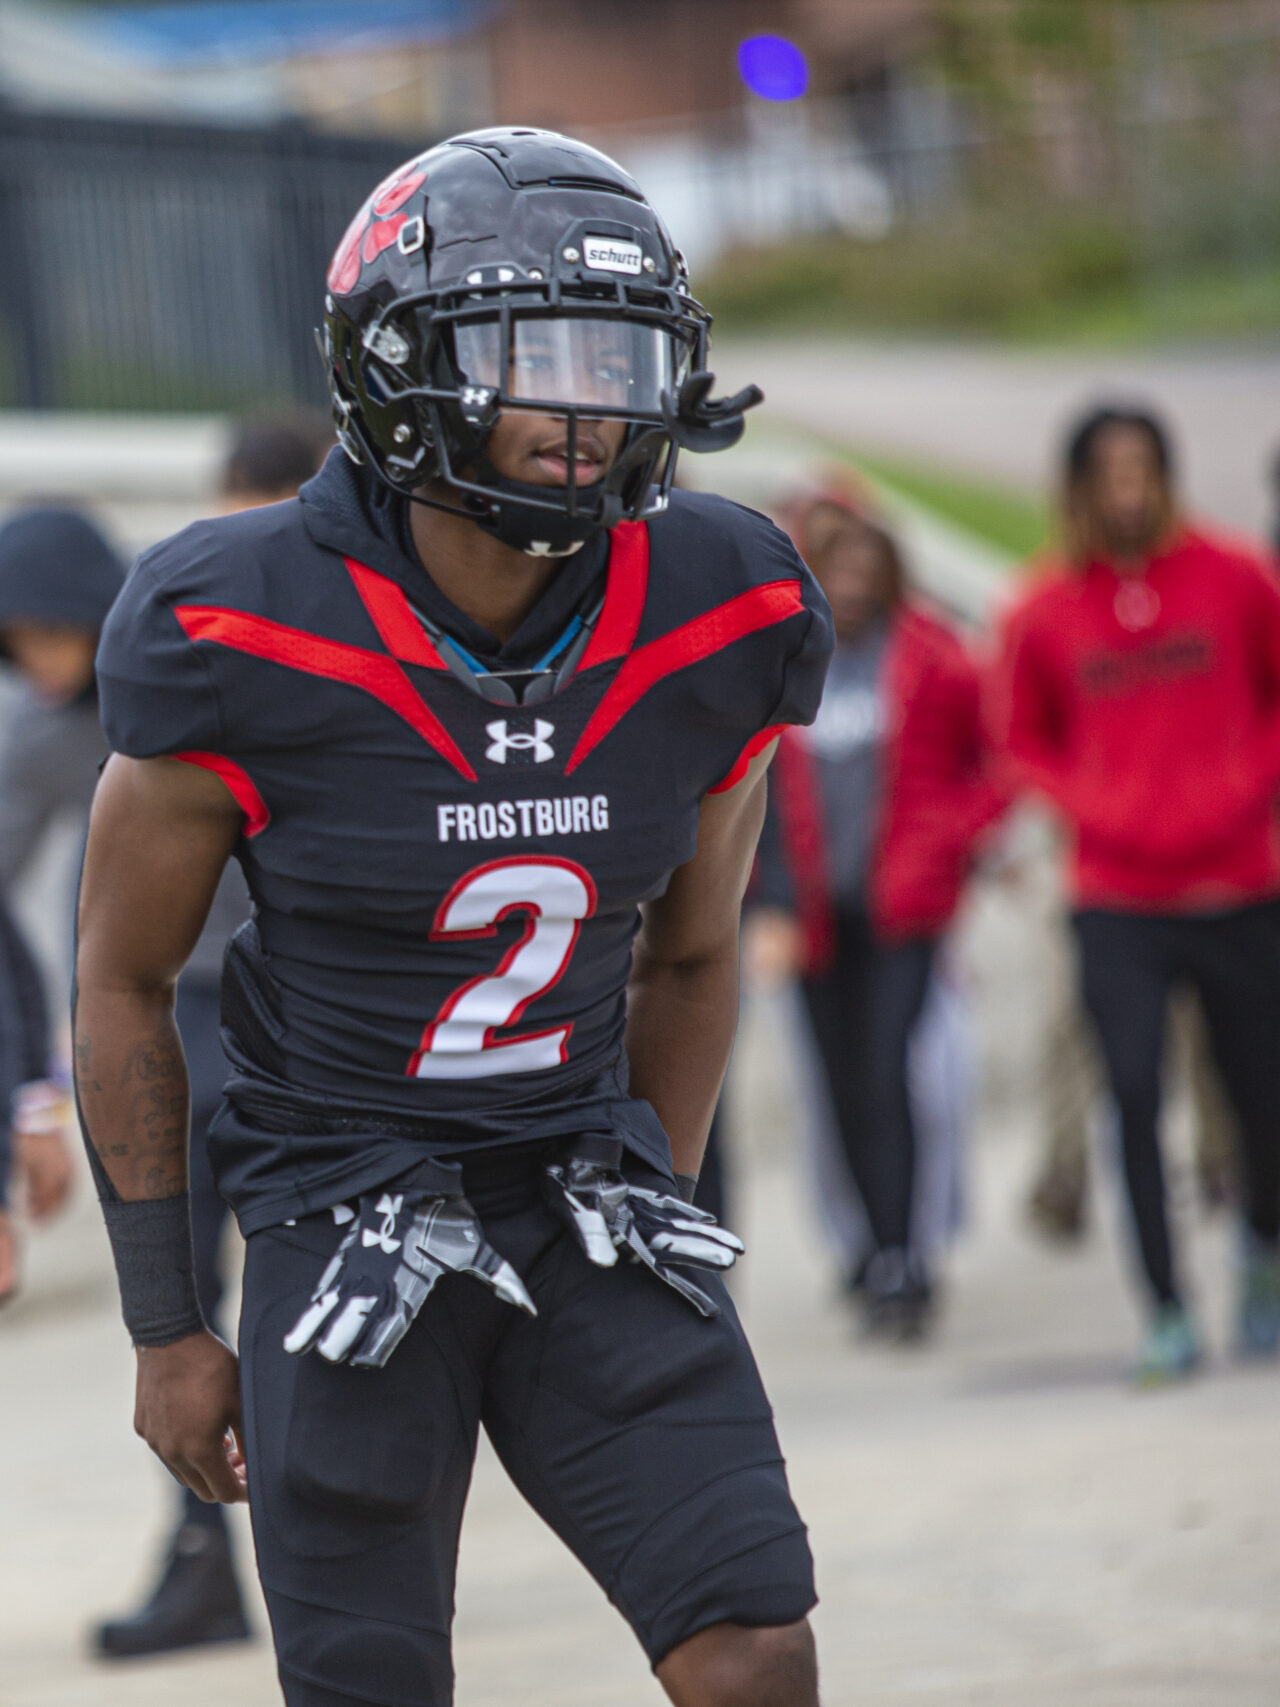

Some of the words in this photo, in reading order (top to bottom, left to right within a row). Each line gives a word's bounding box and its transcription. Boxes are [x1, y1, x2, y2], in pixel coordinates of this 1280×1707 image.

[589, 247, 639, 266] schutt
[436, 794, 610, 842] FROSTBURG
[409, 853, 598, 1080] 2
